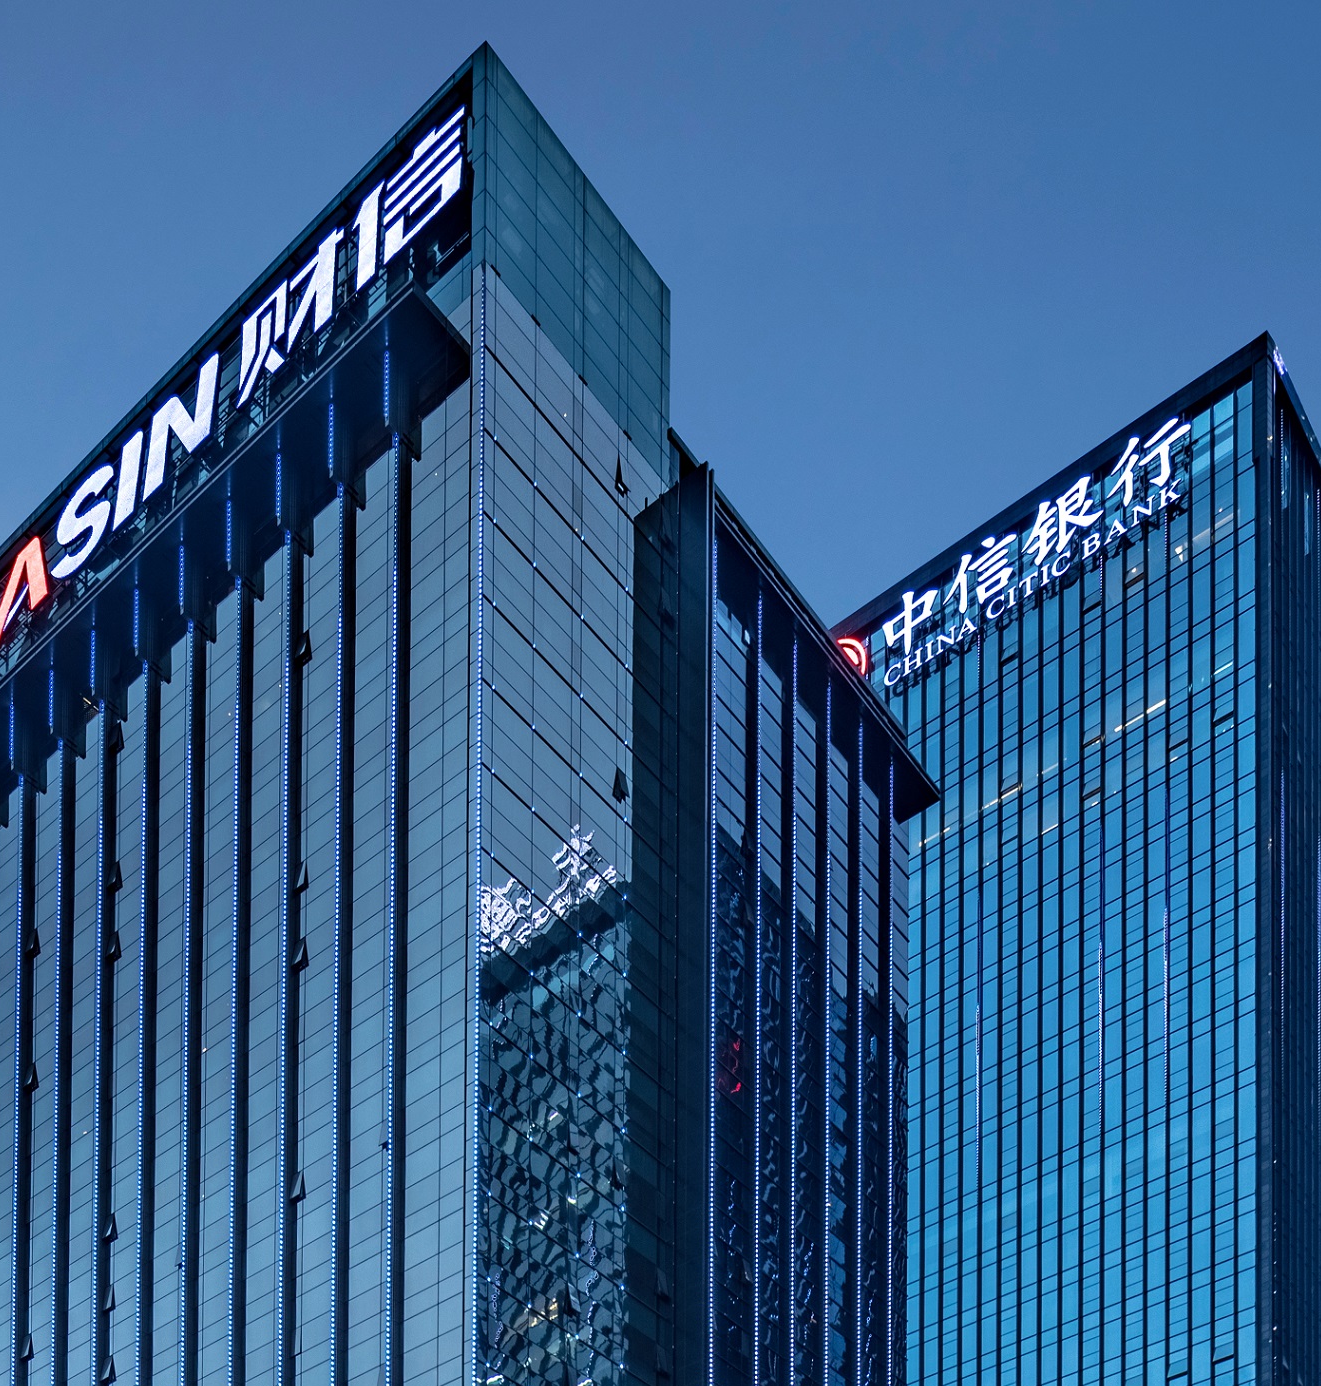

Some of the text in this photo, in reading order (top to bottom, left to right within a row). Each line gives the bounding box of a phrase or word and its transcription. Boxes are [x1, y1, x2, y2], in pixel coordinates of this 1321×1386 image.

[238, 105, 466, 408] 财信
[882, 418, 1191, 656] 中信银行
[883, 478, 1183, 687] CHINA CITIC BANK
